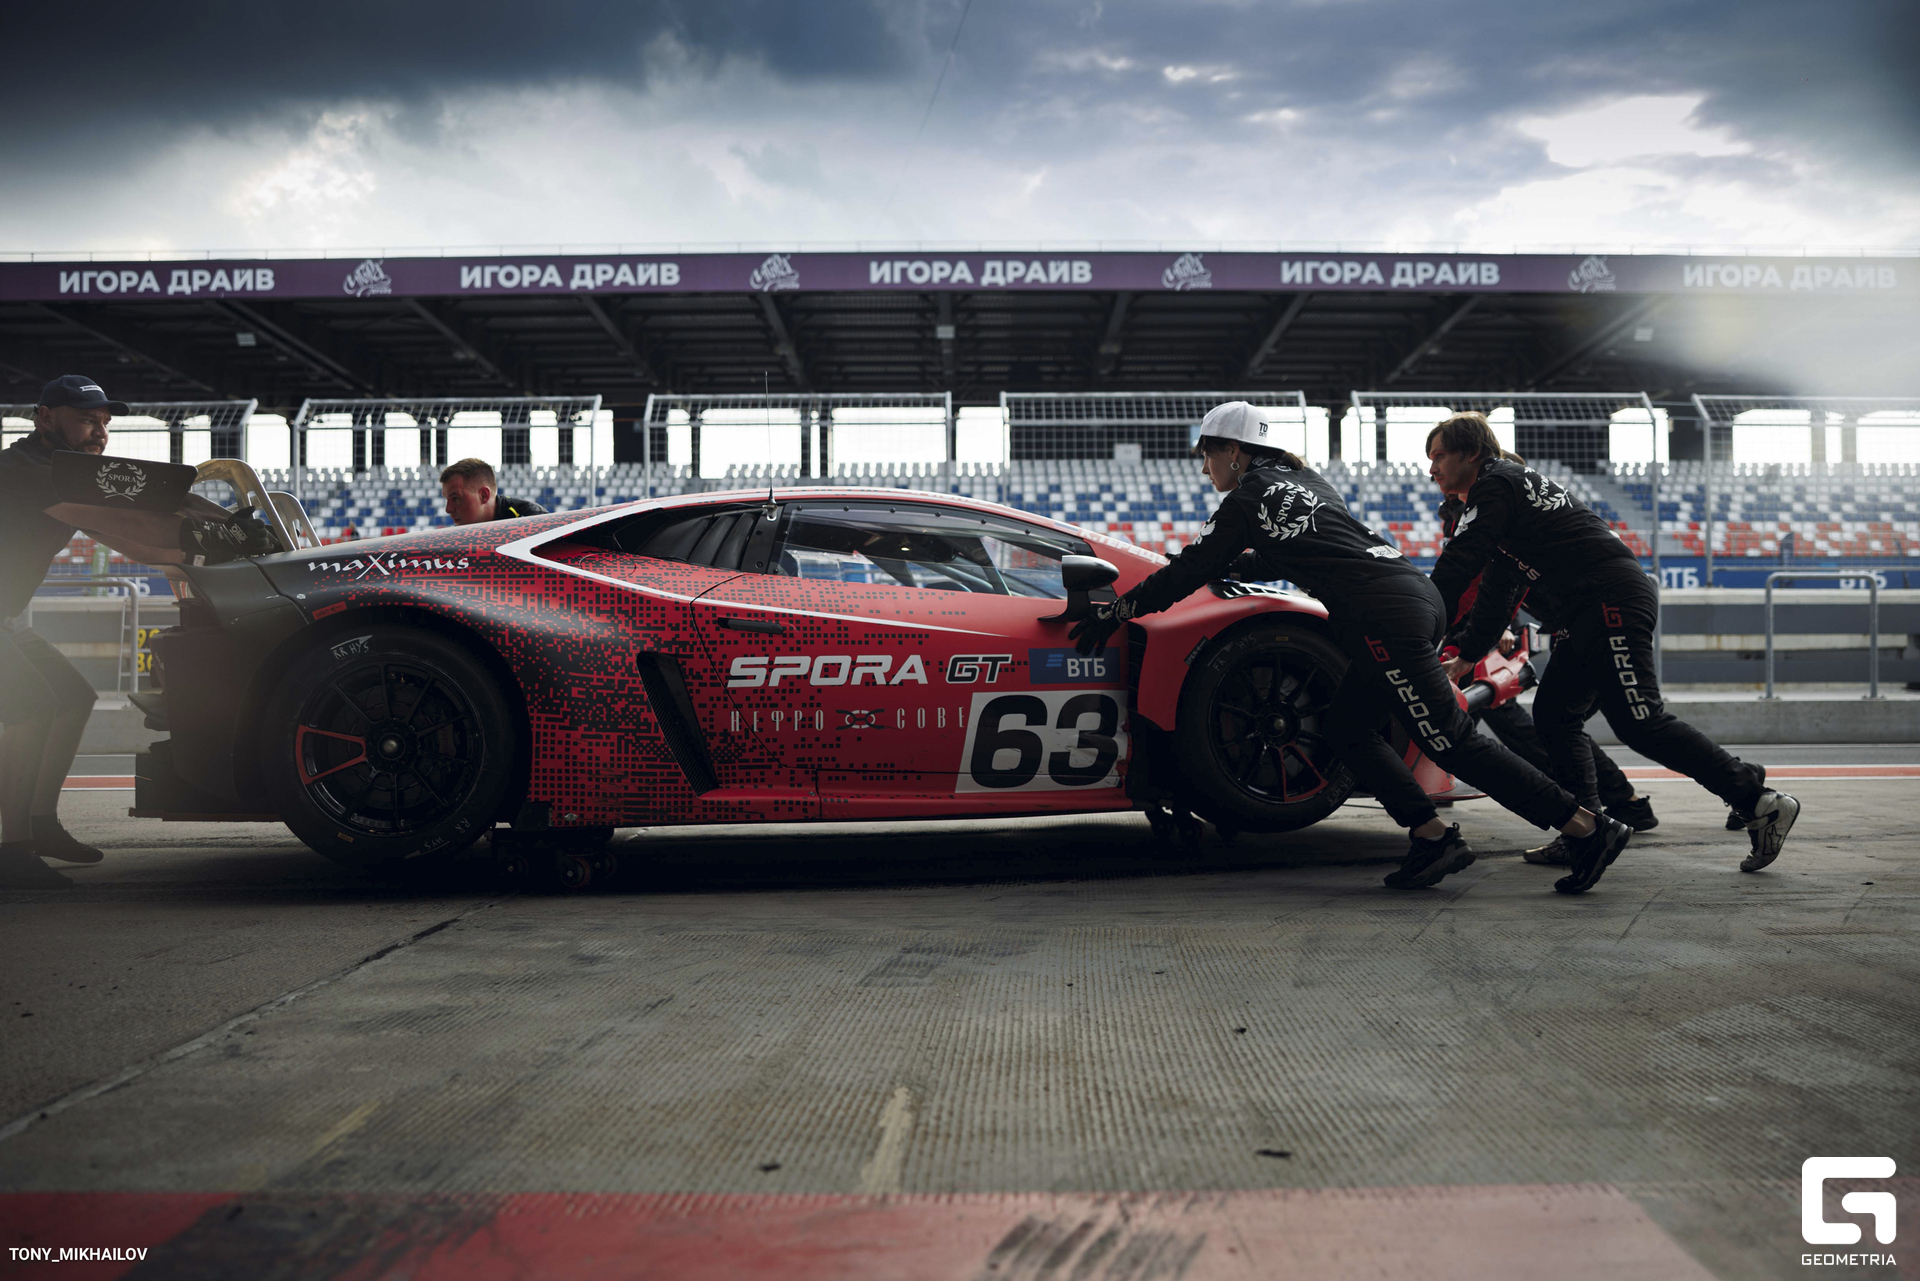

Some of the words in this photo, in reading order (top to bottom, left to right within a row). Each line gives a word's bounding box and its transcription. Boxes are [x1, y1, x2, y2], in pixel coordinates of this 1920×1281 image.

[59, 270, 160, 293] ИГОРА
[167, 268, 275, 295] ДРАЙВ
[461, 265, 563, 288] ИГОРА
[570, 263, 680, 290] ДРАЙВ
[869, 261, 974, 284] ИГОРА
[980, 261, 1092, 287] ДРАЙВ
[1281, 261, 1384, 285] ИГОРА
[1390, 262, 1500, 288] ДРАЙВ
[1683, 263, 1782, 288] ИГОРА
[1790, 264, 1898, 291] ДРАЙВ
[107, 472, 137, 484] SPORA
[1275, 489, 1298, 524] SPORA
[1601, 602, 1623, 627] GT
[1364, 635, 1391, 662] GT
[727, 654, 929, 688] SPORA
[945, 654, 1013, 684] GT
[1066, 657, 1107, 678] ВТБ
[1609, 635, 1651, 721] SPORA
[731, 709, 824, 733] НЕФРО
[1385, 668, 1453, 752] SPORA
[970, 693, 1120, 790] 63
